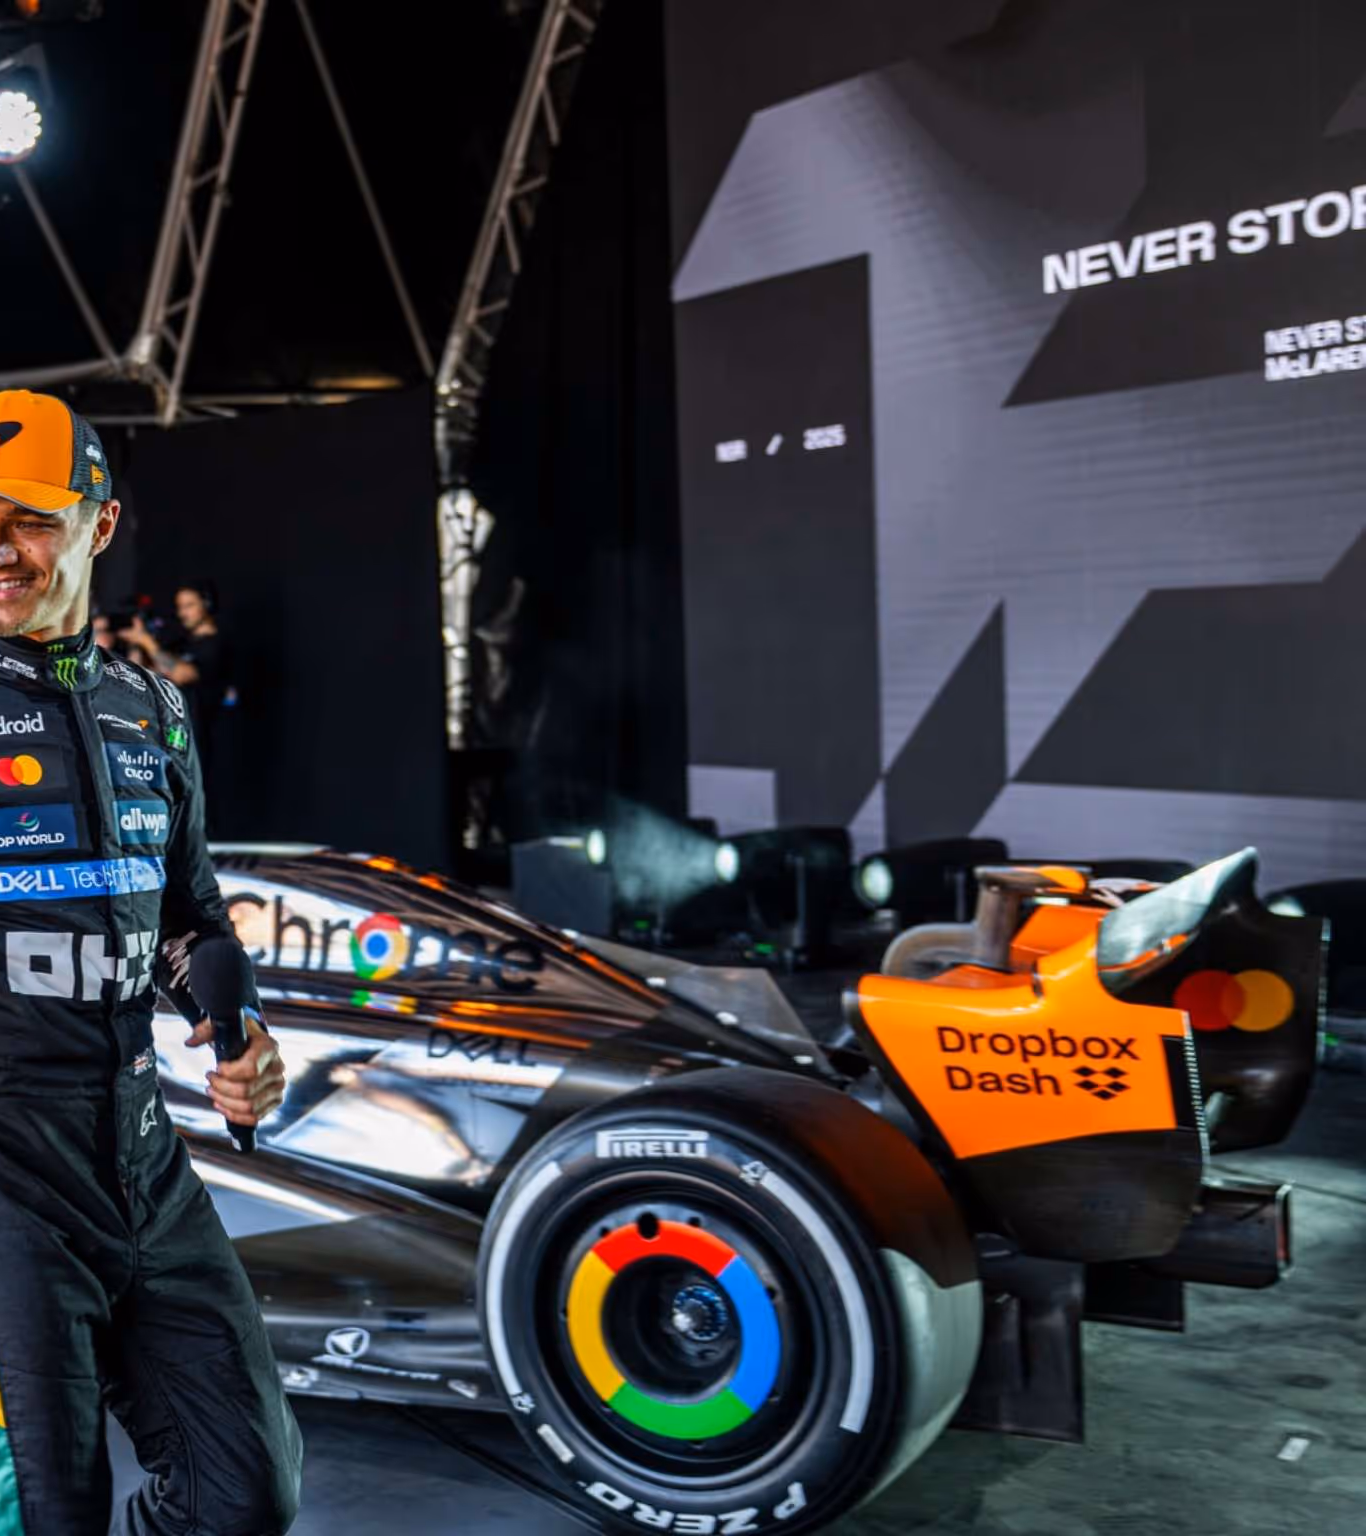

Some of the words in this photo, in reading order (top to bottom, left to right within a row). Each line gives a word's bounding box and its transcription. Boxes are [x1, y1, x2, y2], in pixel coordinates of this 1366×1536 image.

[1043, 220, 1216, 294] NEVER
[1265, 319, 1343, 354] NEVER
[17, 832, 65, 845] WORLD
[427, 1027, 537, 1067] DELL
[937, 1023, 1140, 1064] Dropbox
[945, 1065, 1062, 1096] Dash
[596, 1129, 710, 1159] PIRELLI
[585, 1481, 760, 1535] ZERO
[773, 1481, 808, 1520] P
